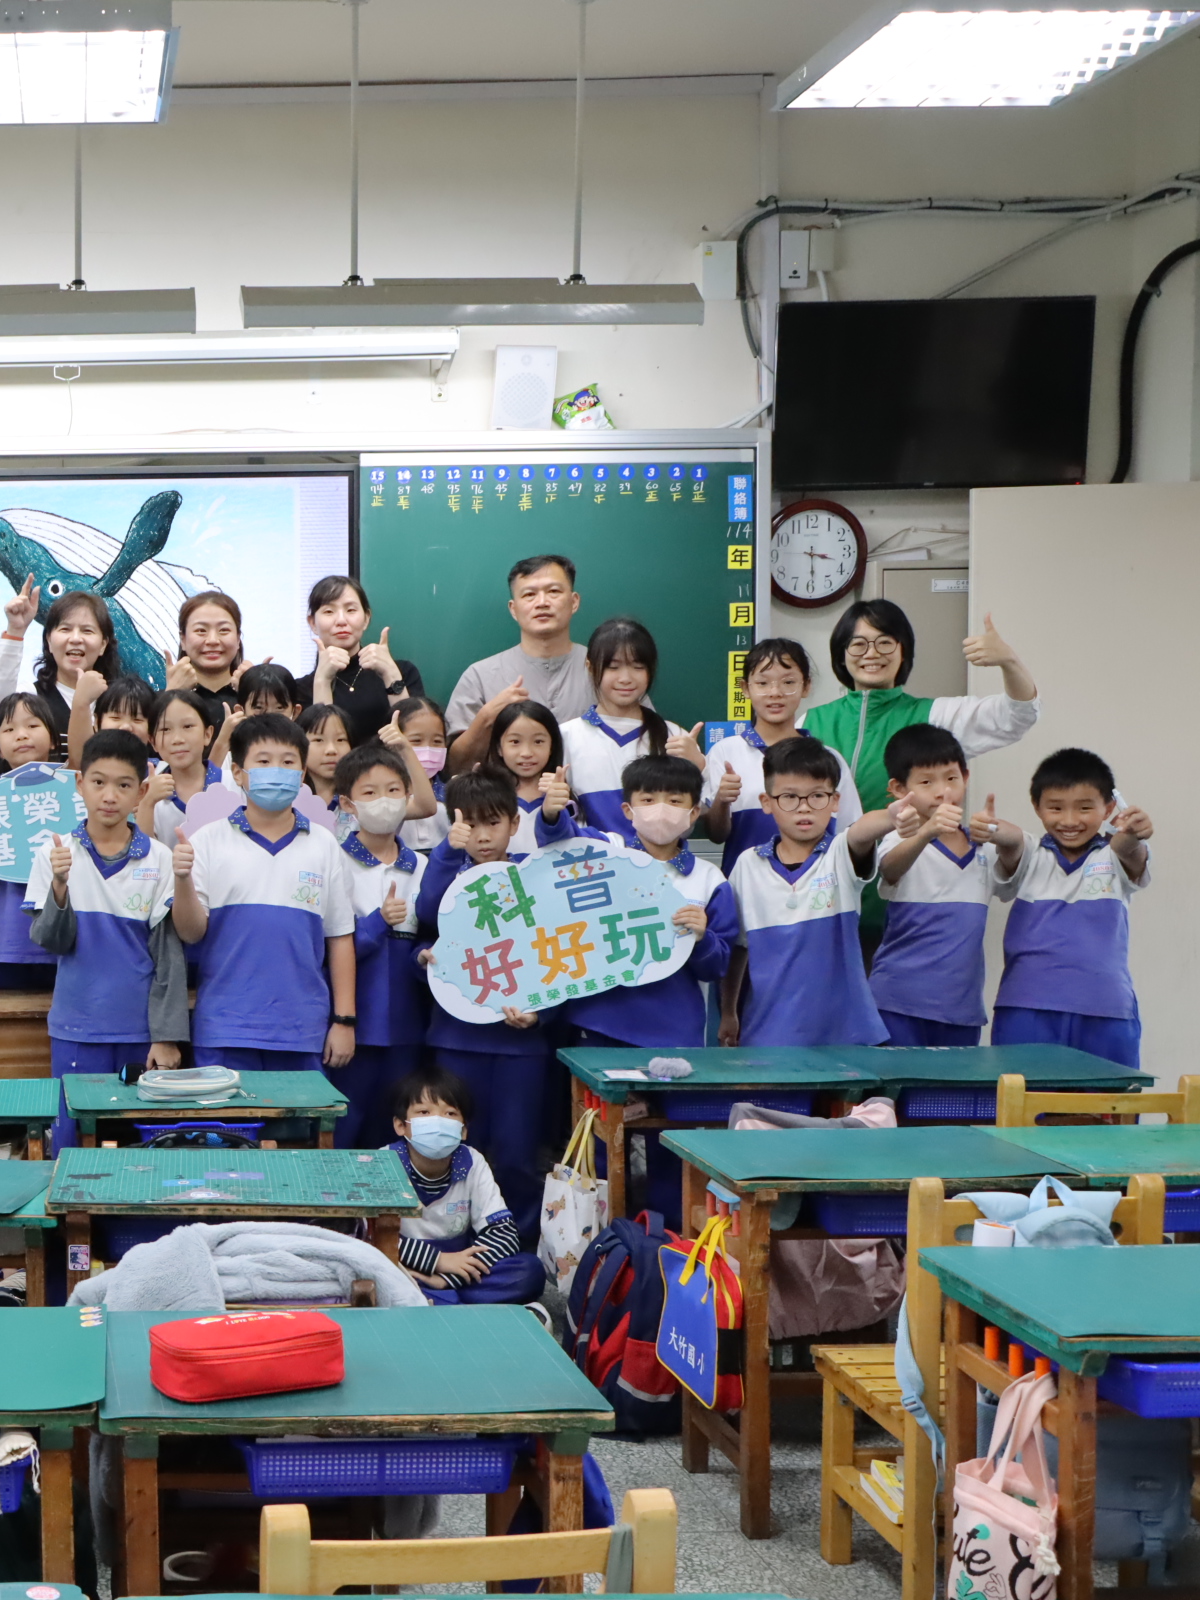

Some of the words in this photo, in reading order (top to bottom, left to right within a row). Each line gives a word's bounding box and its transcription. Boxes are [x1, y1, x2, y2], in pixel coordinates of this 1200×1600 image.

[371, 470, 385, 480] 15
[421, 470, 435, 480] 13
[446, 470, 461, 480] 12
[472, 470, 484, 480] 11
[498, 469, 506, 478] 9
[522, 468, 530, 478] 8
[548, 468, 556, 478] 7
[571, 468, 579, 477] 6
[596, 468, 604, 478] 5
[622, 468, 630, 477] 4
[647, 468, 656, 477] 3
[672, 467, 680, 477] 2
[696, 468, 702, 478] 1
[370, 484, 385, 495] 74
[420, 483, 435, 494] 48
[447, 484, 461, 494] 95
[471, 484, 484, 495] 76
[494, 484, 508, 494] 45
[521, 484, 533, 494] 95
[546, 482, 558, 492] 85
[568, 482, 582, 492] 47
[594, 482, 607, 492] 82
[618, 482, 631, 492] 39
[646, 481, 660, 490] 60
[669, 482, 682, 492] 65
[693, 481, 704, 492] 61
[733, 477, 748, 520] 聯絡簿
[726, 523, 753, 539] 114
[792, 520, 801, 534] 11
[827, 517, 831, 532] 1
[806, 514, 819, 530] 12
[776, 532, 790, 548] 10
[836, 528, 846, 542] 2
[730, 548, 751, 568] 年
[770, 549, 779, 564] 9
[842, 544, 852, 560] 3
[776, 566, 786, 580] 8
[836, 562, 845, 576] 4
[790, 576, 799, 592] 7
[806, 579, 815, 594] 6
[824, 574, 833, 590] 5
[733, 606, 750, 624] 月
[733, 654, 748, 673] 日
[733, 676, 746, 718] 星期四
[464, 845, 616, 938] 科普
[460, 906, 672, 1006] 好好玩
[528, 970, 635, 1007] 張榮發基金會
[668, 1326, 705, 1376] 大竹國小
